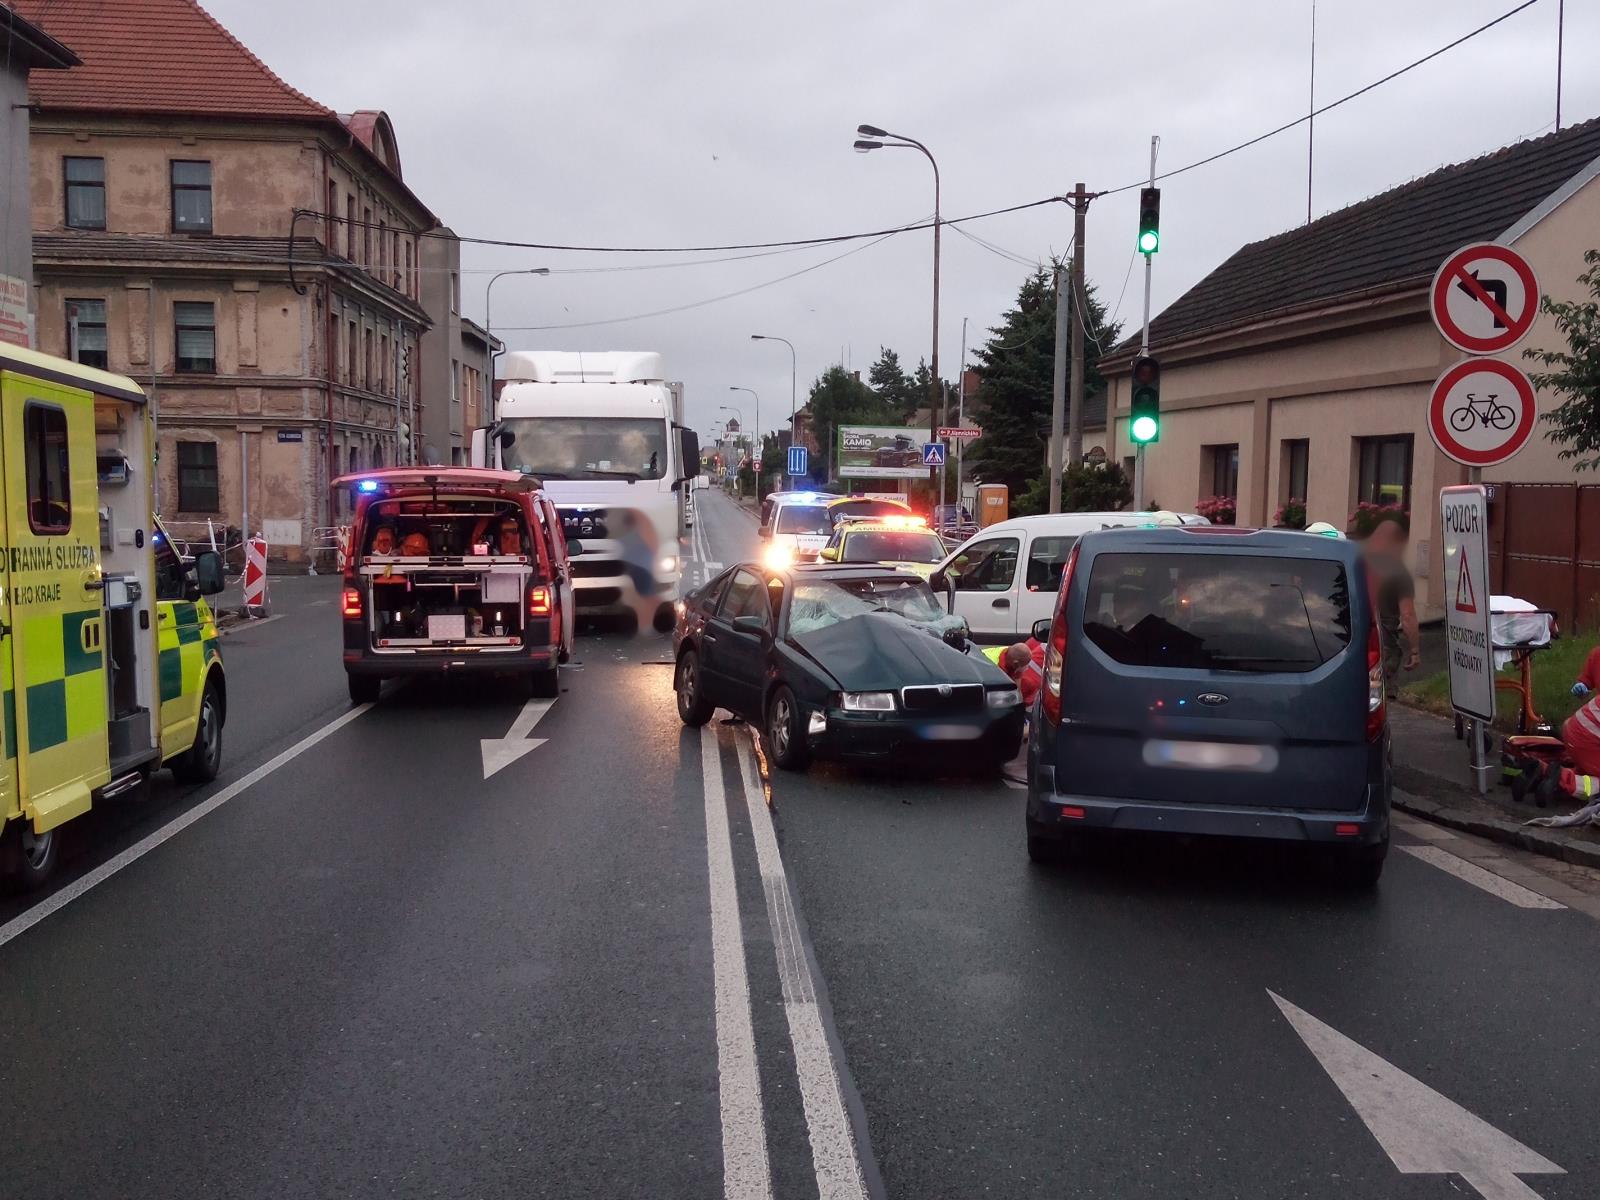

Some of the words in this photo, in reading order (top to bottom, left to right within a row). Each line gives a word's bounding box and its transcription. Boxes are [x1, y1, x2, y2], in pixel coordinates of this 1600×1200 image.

[843, 438, 872, 446] KAMIQ
[1446, 504, 1478, 534] POZOR
[55, 537, 96, 570] SLUŽBA
[35, 583, 61, 604] KRAJE
[1450, 625, 1485, 649] REKONSTRUKCE
